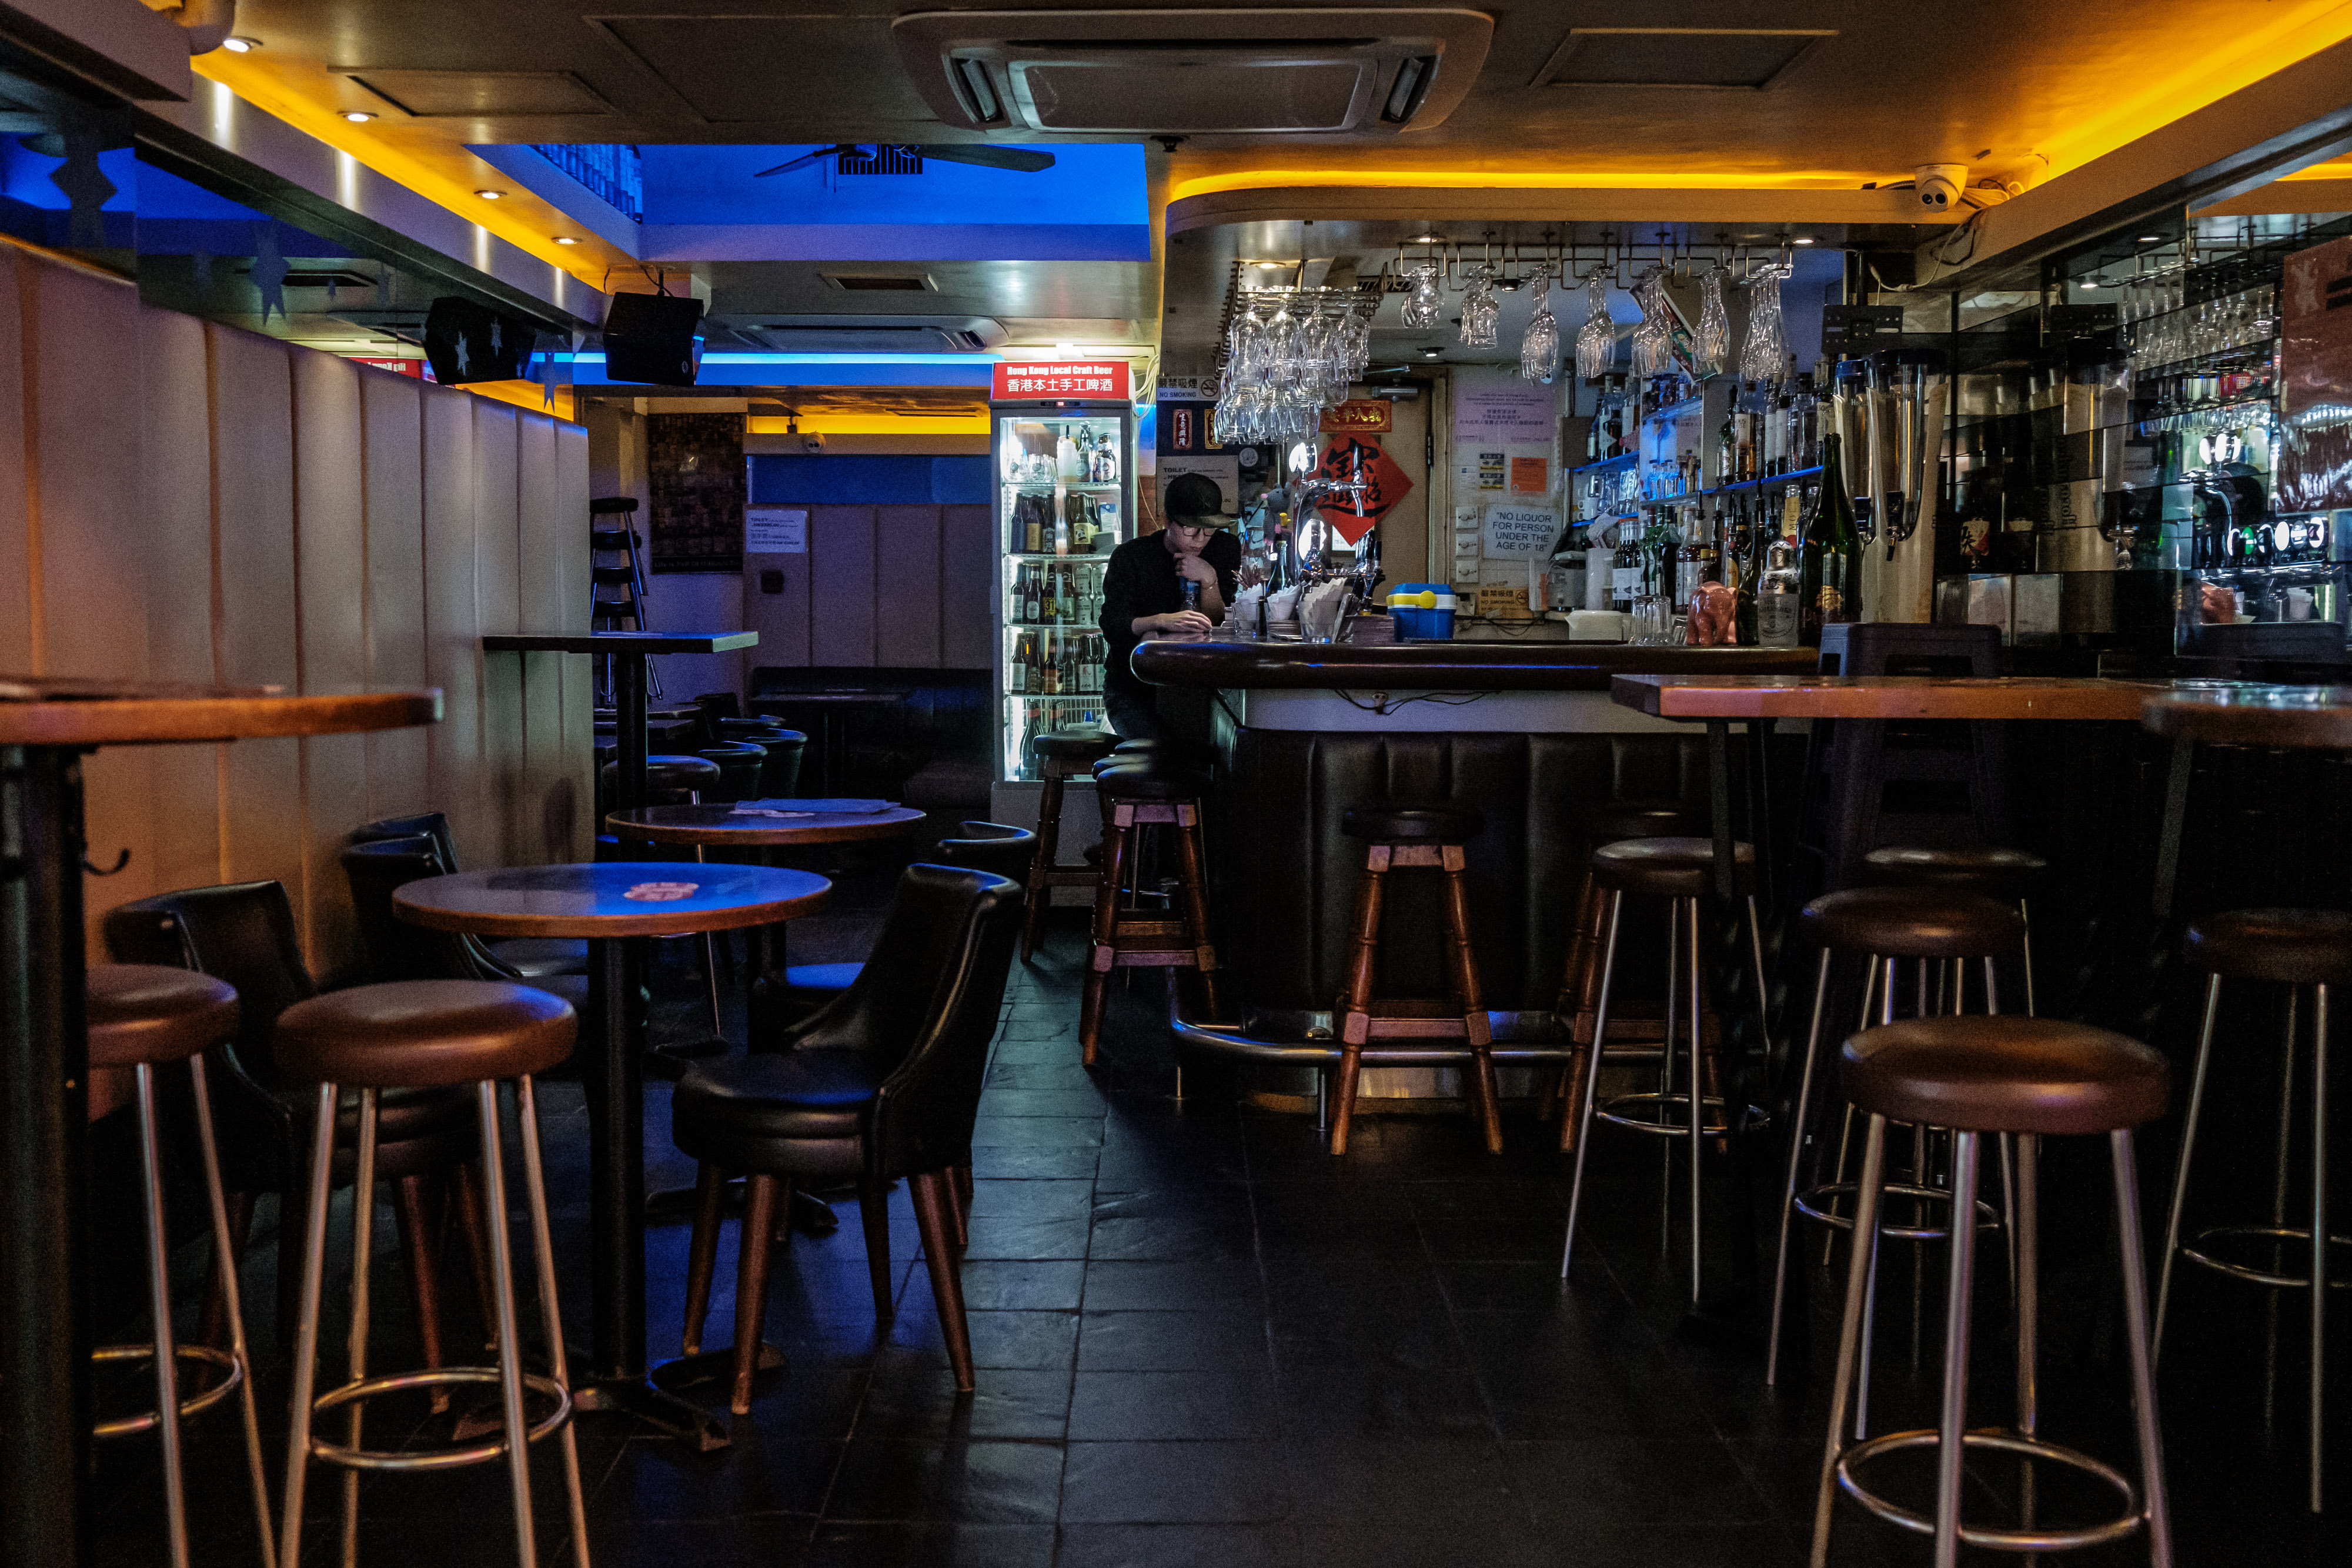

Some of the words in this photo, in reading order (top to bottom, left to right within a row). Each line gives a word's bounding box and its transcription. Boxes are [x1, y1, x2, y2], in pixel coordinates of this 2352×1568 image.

[1007, 366, 1027, 375] Hong
[1029, 366, 1049, 375] Kong
[1050, 365, 1071, 375] Local
[1073, 365, 1092, 375] Craft
[1094, 365, 1112, 375] Beer
[1007, 378, 1112, 392] 香港本土手工啤酒
[1159, 378, 1198, 388] 嚴禁吸煙
[1516, 513, 1552, 522] LIQUOR
[1493, 521, 1512, 530] FOR
[1515, 523, 1553, 533] PERSON
[1496, 531, 1528, 541] UNDER
[1531, 534, 1549, 542] THE
[1496, 541, 1515, 550] AGE
